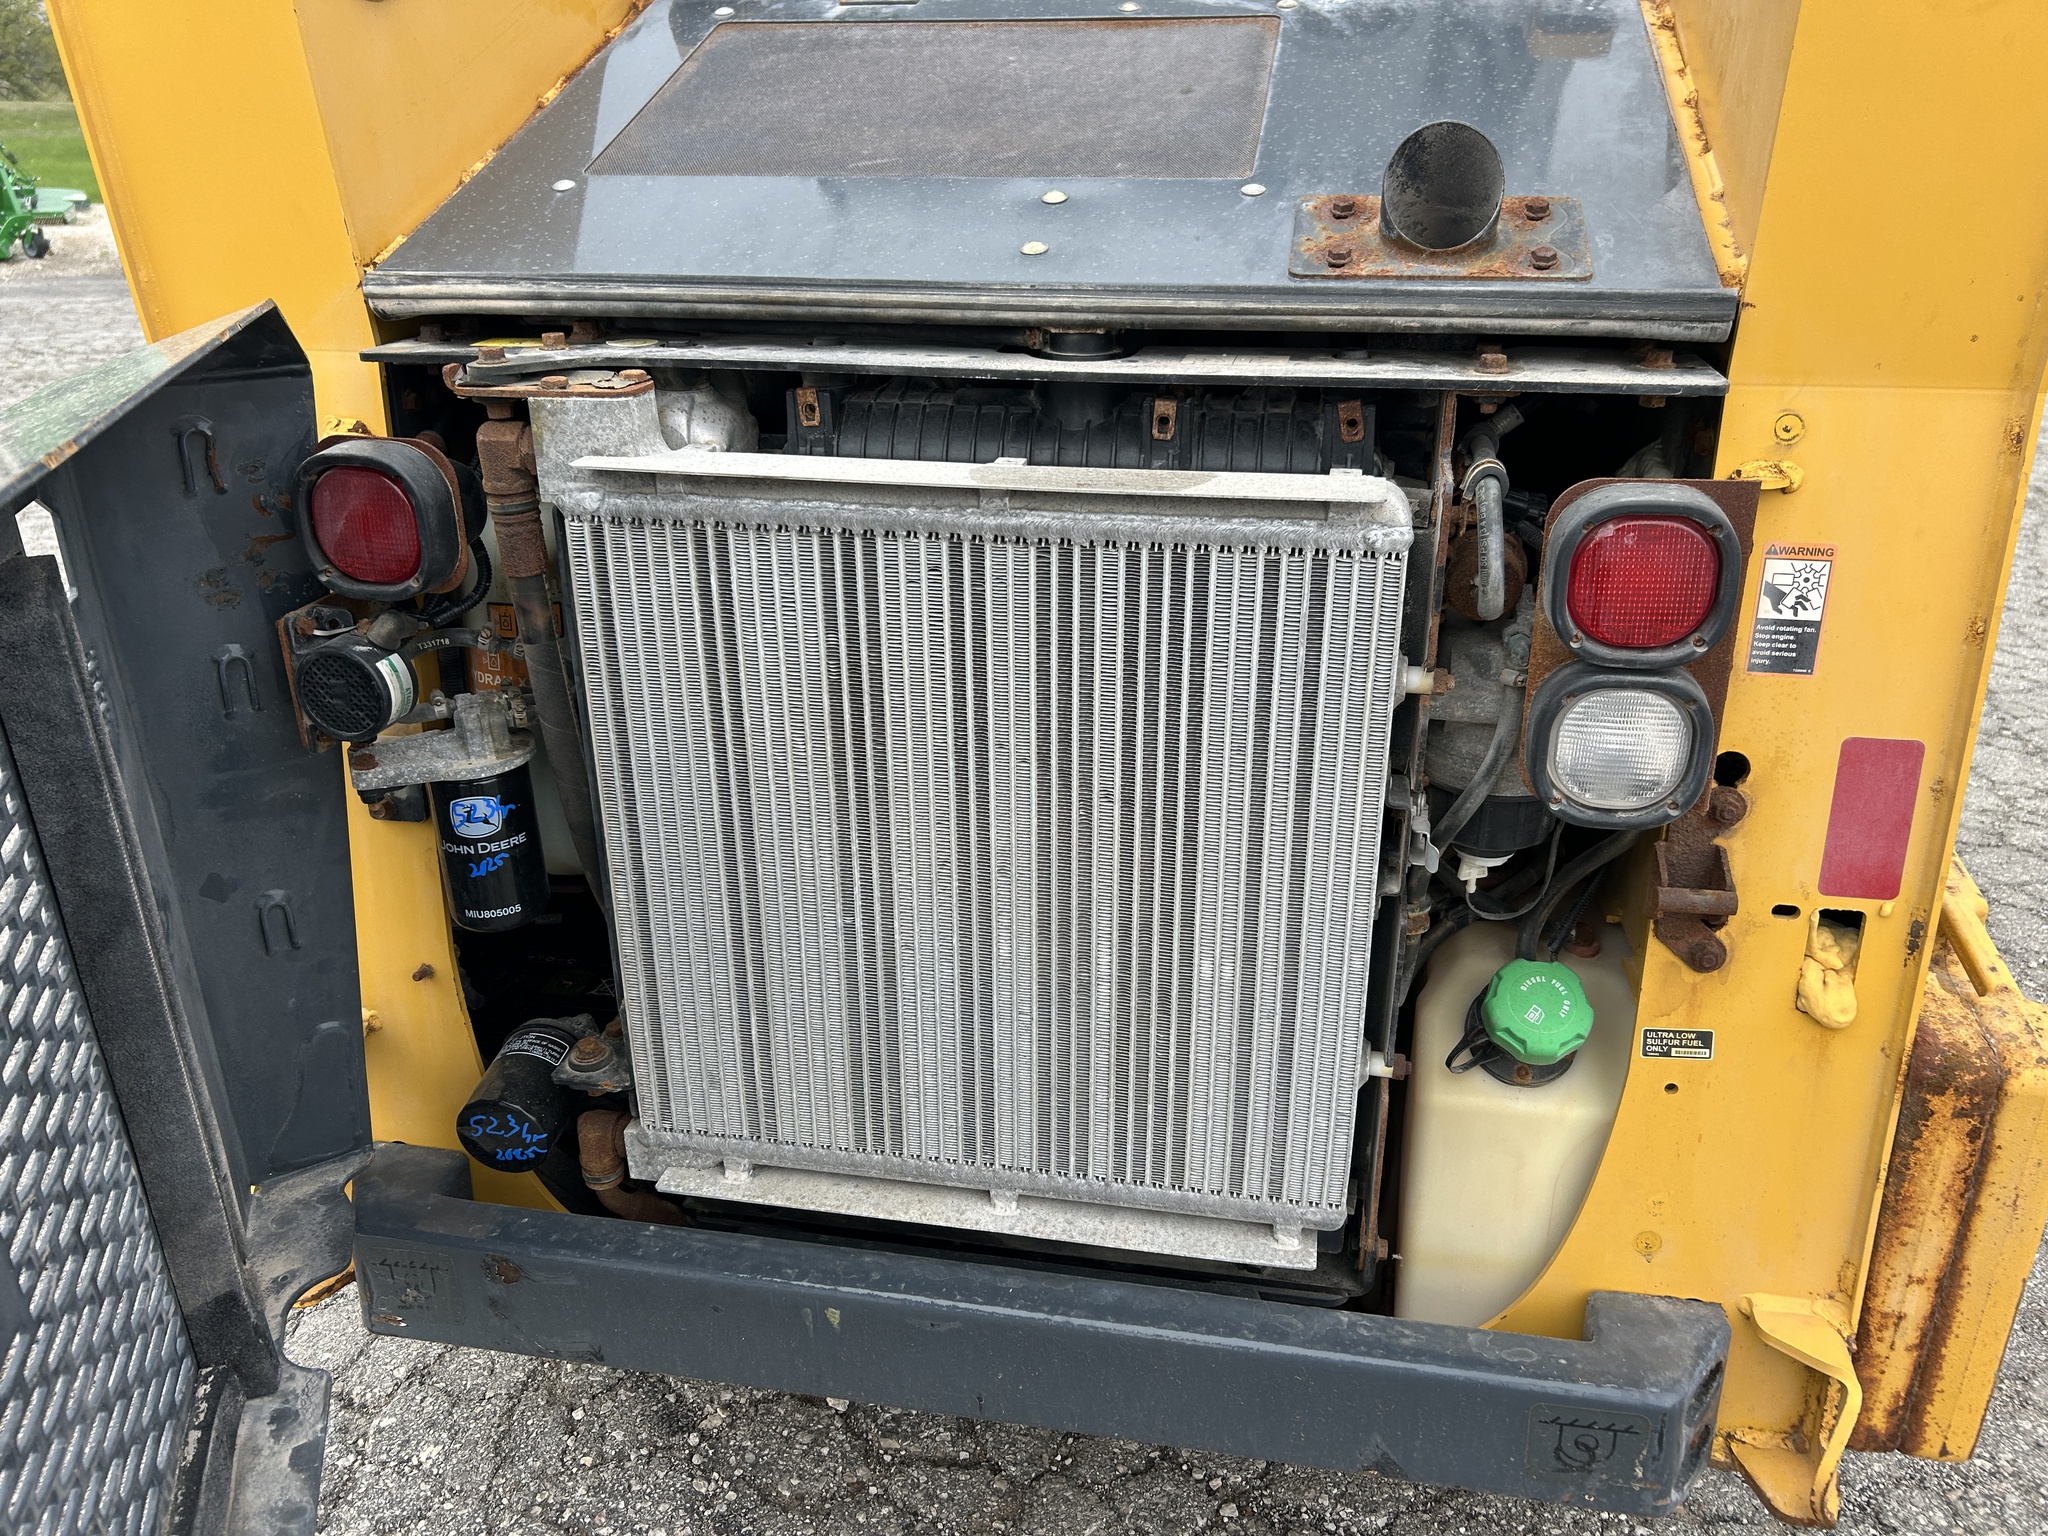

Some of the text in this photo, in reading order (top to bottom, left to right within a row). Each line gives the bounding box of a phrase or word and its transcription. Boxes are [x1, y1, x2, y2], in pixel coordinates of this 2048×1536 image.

[1479, 538, 1488, 554] PSI
[1779, 546, 1834, 557] WARNING
[1776, 625, 1803, 633] rotating
[418, 638, 450, 651] T331718
[1750, 657, 1771, 665] injury.
[441, 832, 527, 855] JOHN DEERE
[465, 904, 521, 919] MIU805005
[1520, 976, 1571, 1018] DIESEL FUEL ONLY
[1646, 1031, 1675, 1039] ULTRA
[1646, 1038, 1704, 1047] SULFUR FUEL
